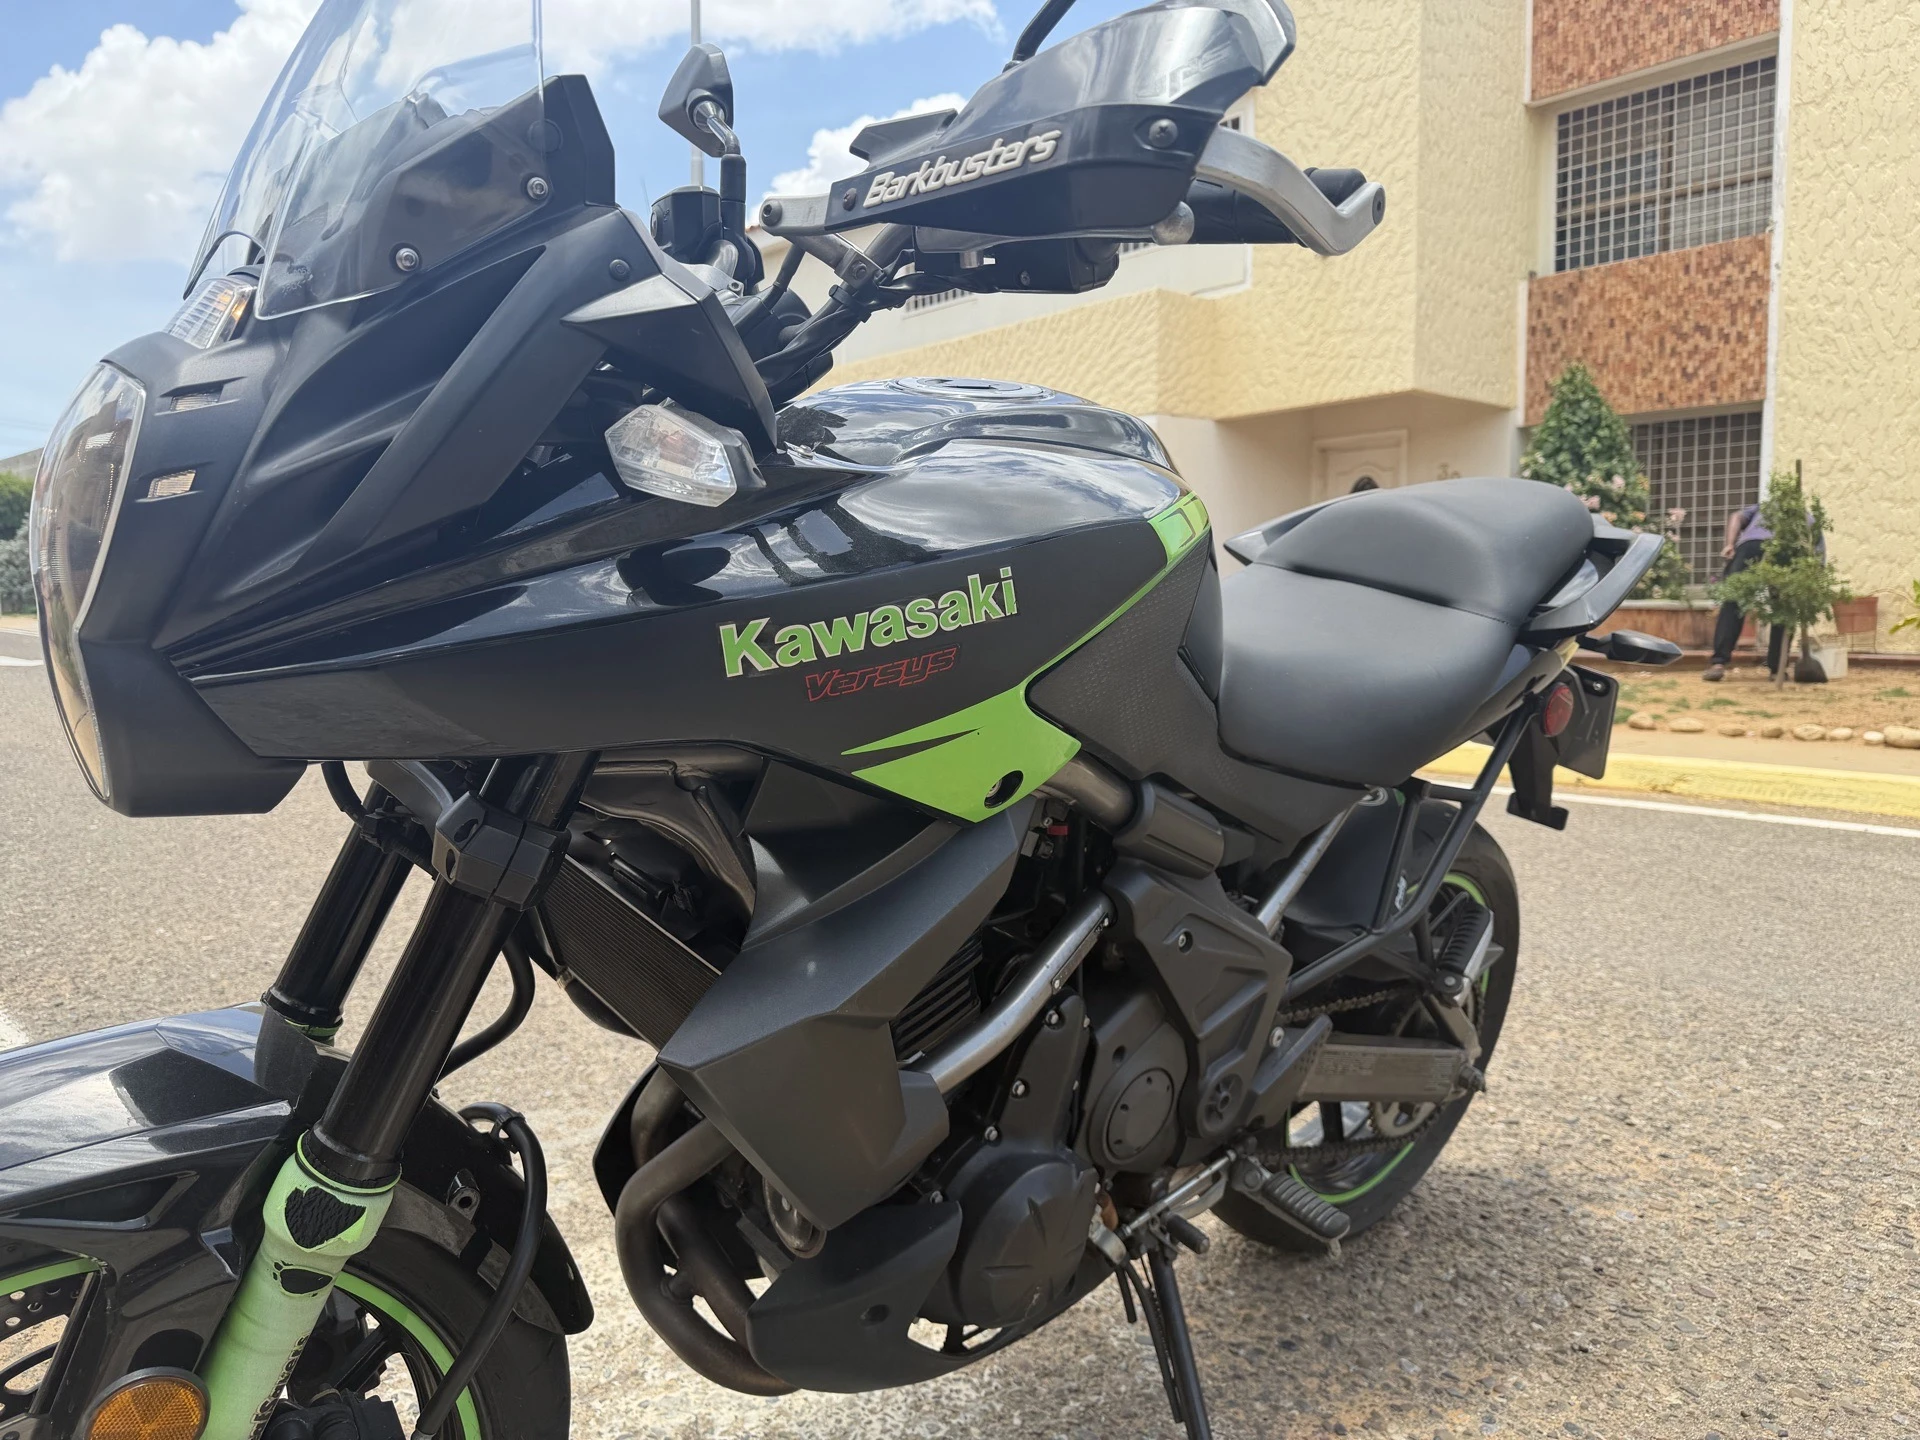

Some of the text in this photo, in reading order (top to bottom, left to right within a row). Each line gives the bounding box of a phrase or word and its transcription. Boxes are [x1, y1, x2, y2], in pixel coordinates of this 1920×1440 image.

[863, 129, 1062, 208] Barkbusters
[719, 566, 1018, 678] Kawasaki
[805, 647, 959, 702] Versys
